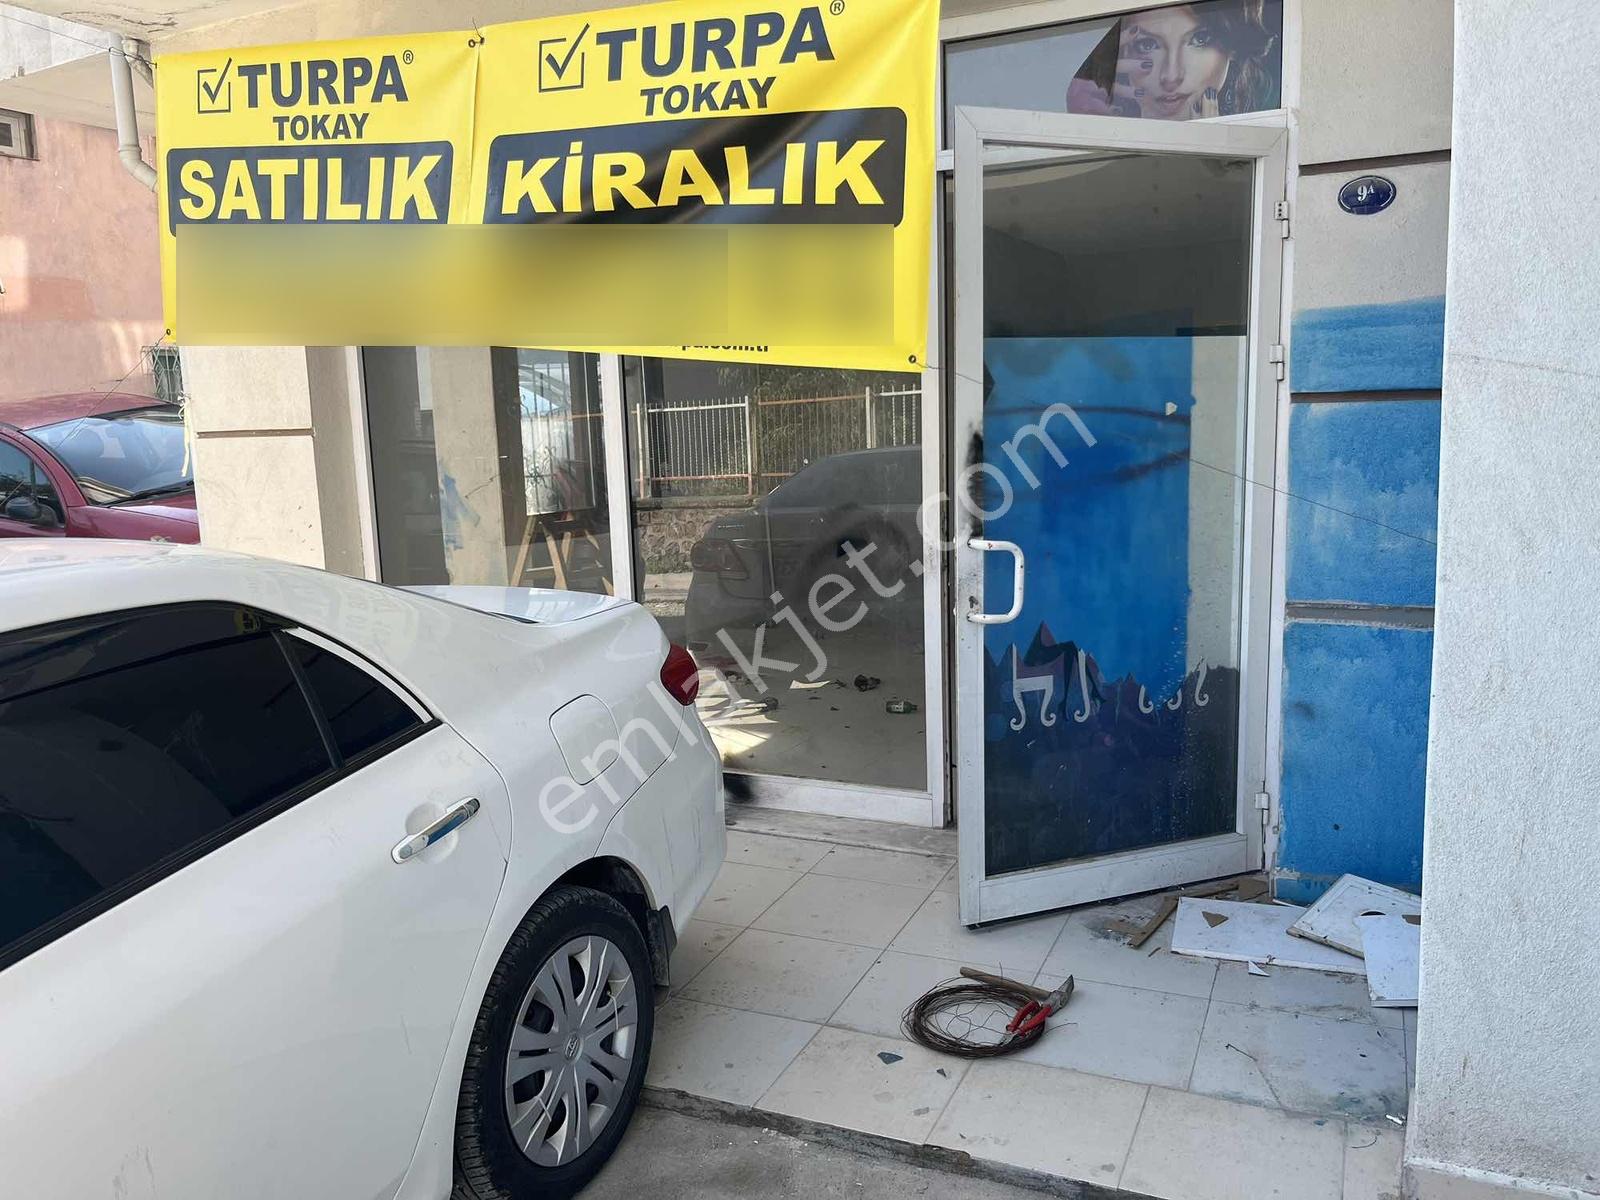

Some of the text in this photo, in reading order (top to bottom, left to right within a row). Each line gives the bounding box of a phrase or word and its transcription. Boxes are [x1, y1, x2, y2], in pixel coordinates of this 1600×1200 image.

[640, 76, 777, 117] TOKAY
[272, 112, 370, 141] TOKAY
[179, 154, 443, 221] SATILIK
[501, 140, 886, 215] KİRALIK
